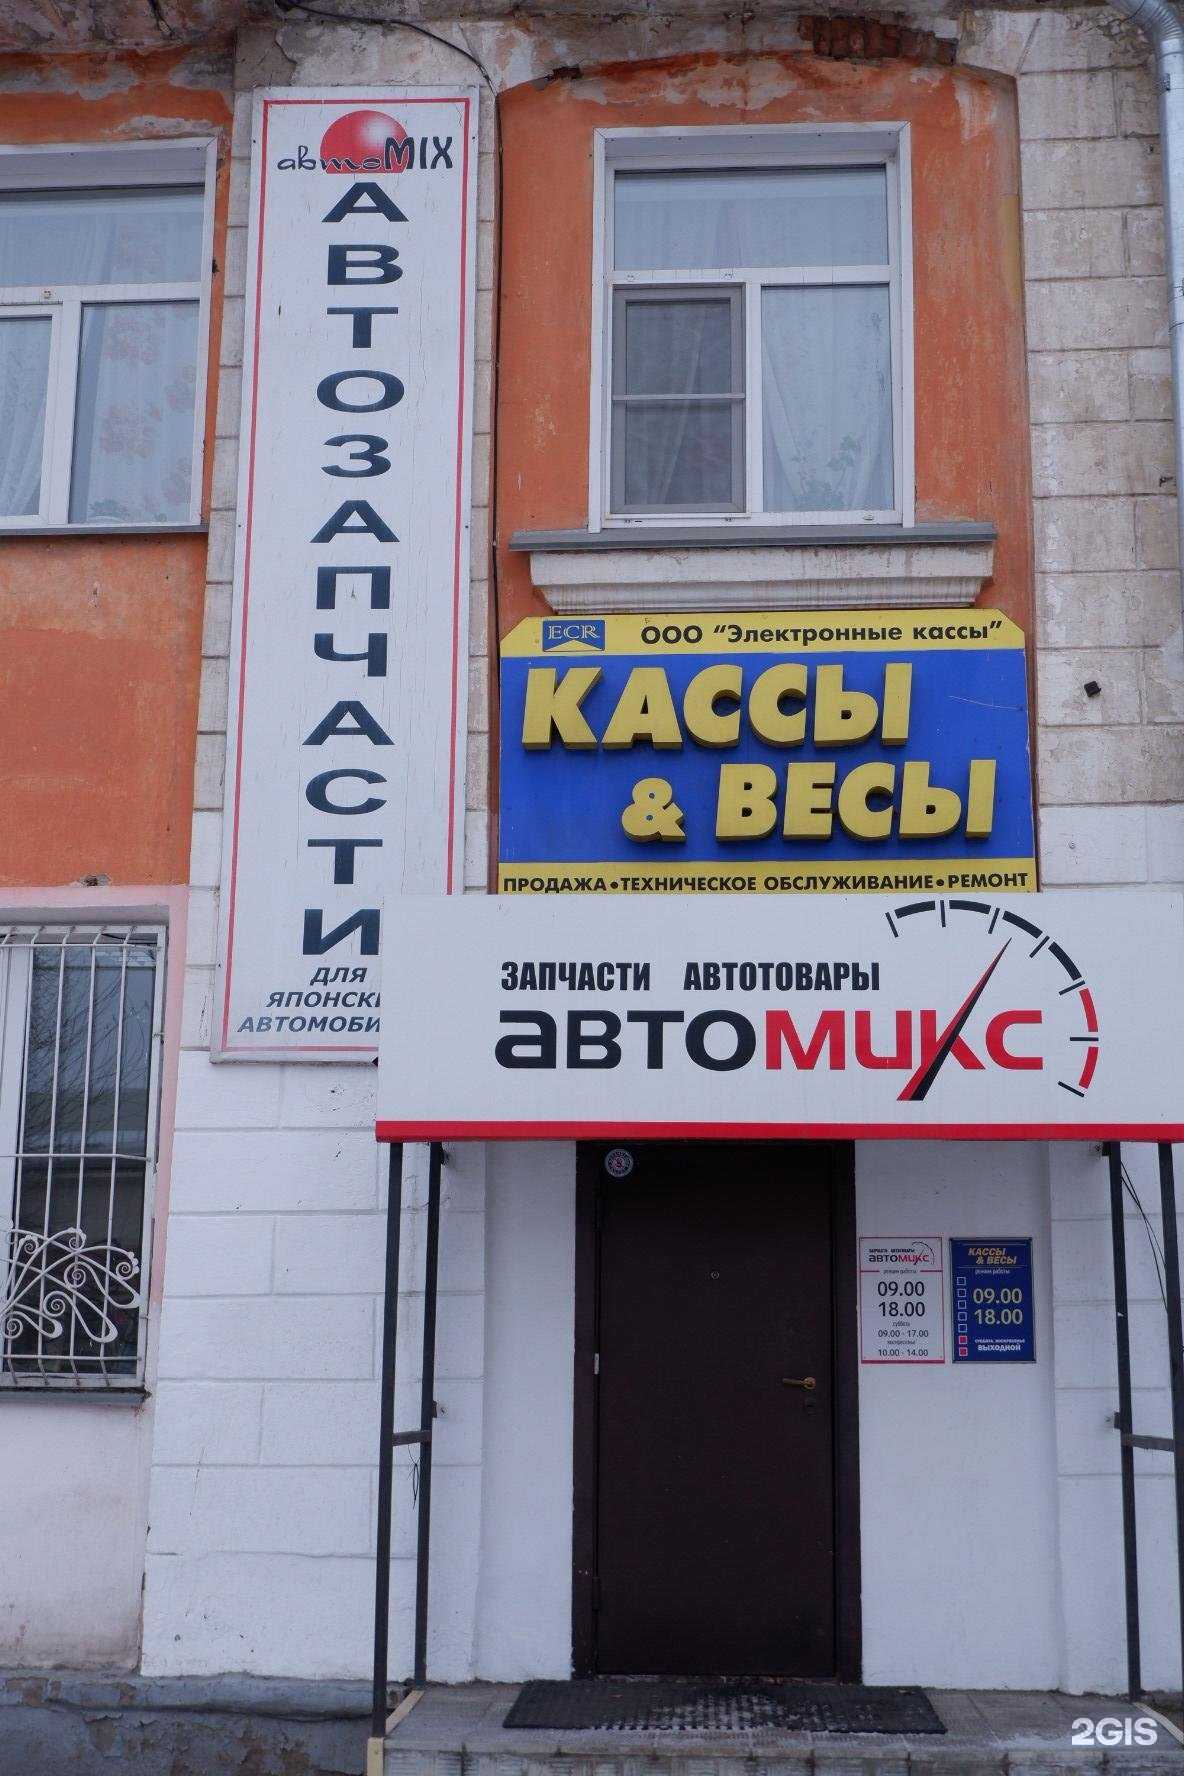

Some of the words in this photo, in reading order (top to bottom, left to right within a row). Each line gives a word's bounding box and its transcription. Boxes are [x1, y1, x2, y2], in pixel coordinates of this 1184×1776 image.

[302, 182, 410, 956] АВТОЗАПЧАСТИ
[547, 624, 601, 640] ECR
[641, 624, 704, 645] ООО
[521, 662, 914, 750] КАССЫ
[620, 777, 687, 844] &
[715, 759, 997, 843] ВЕСЫ
[503, 876, 608, 894] ПРОДАЖА
[620, 876, 757, 892] ТЕХНИЧЕСКОЕ
[763, 874, 934, 891] ОБСЛУЖИВАНИЕ
[948, 872, 1029, 889] РЕМОНТ
[309, 966, 368, 987] ДЛЯ
[500, 961, 652, 992] ЗАПЧАСТИ
[683, 960, 881, 992] АВТОТОВАРЫ
[967, 1247, 1007, 1256] КАССЫ
[986, 1256, 1018, 1265] ВЕСЫ
[877, 1281, 925, 1297] 09.00
[972, 1288, 1023, 1304] 09.00
[878, 1301, 926, 1317] 18.00
[974, 1308, 1024, 1325] 18.00
[877, 1329, 900, 1338] 09.00
[907, 1329, 929, 1338] 17.00
[878, 1348, 900, 1357] 10.00
[907, 1348, 929, 1357] 14.00
[977, 1343, 1022, 1352] ВЫХОДНОЙ
